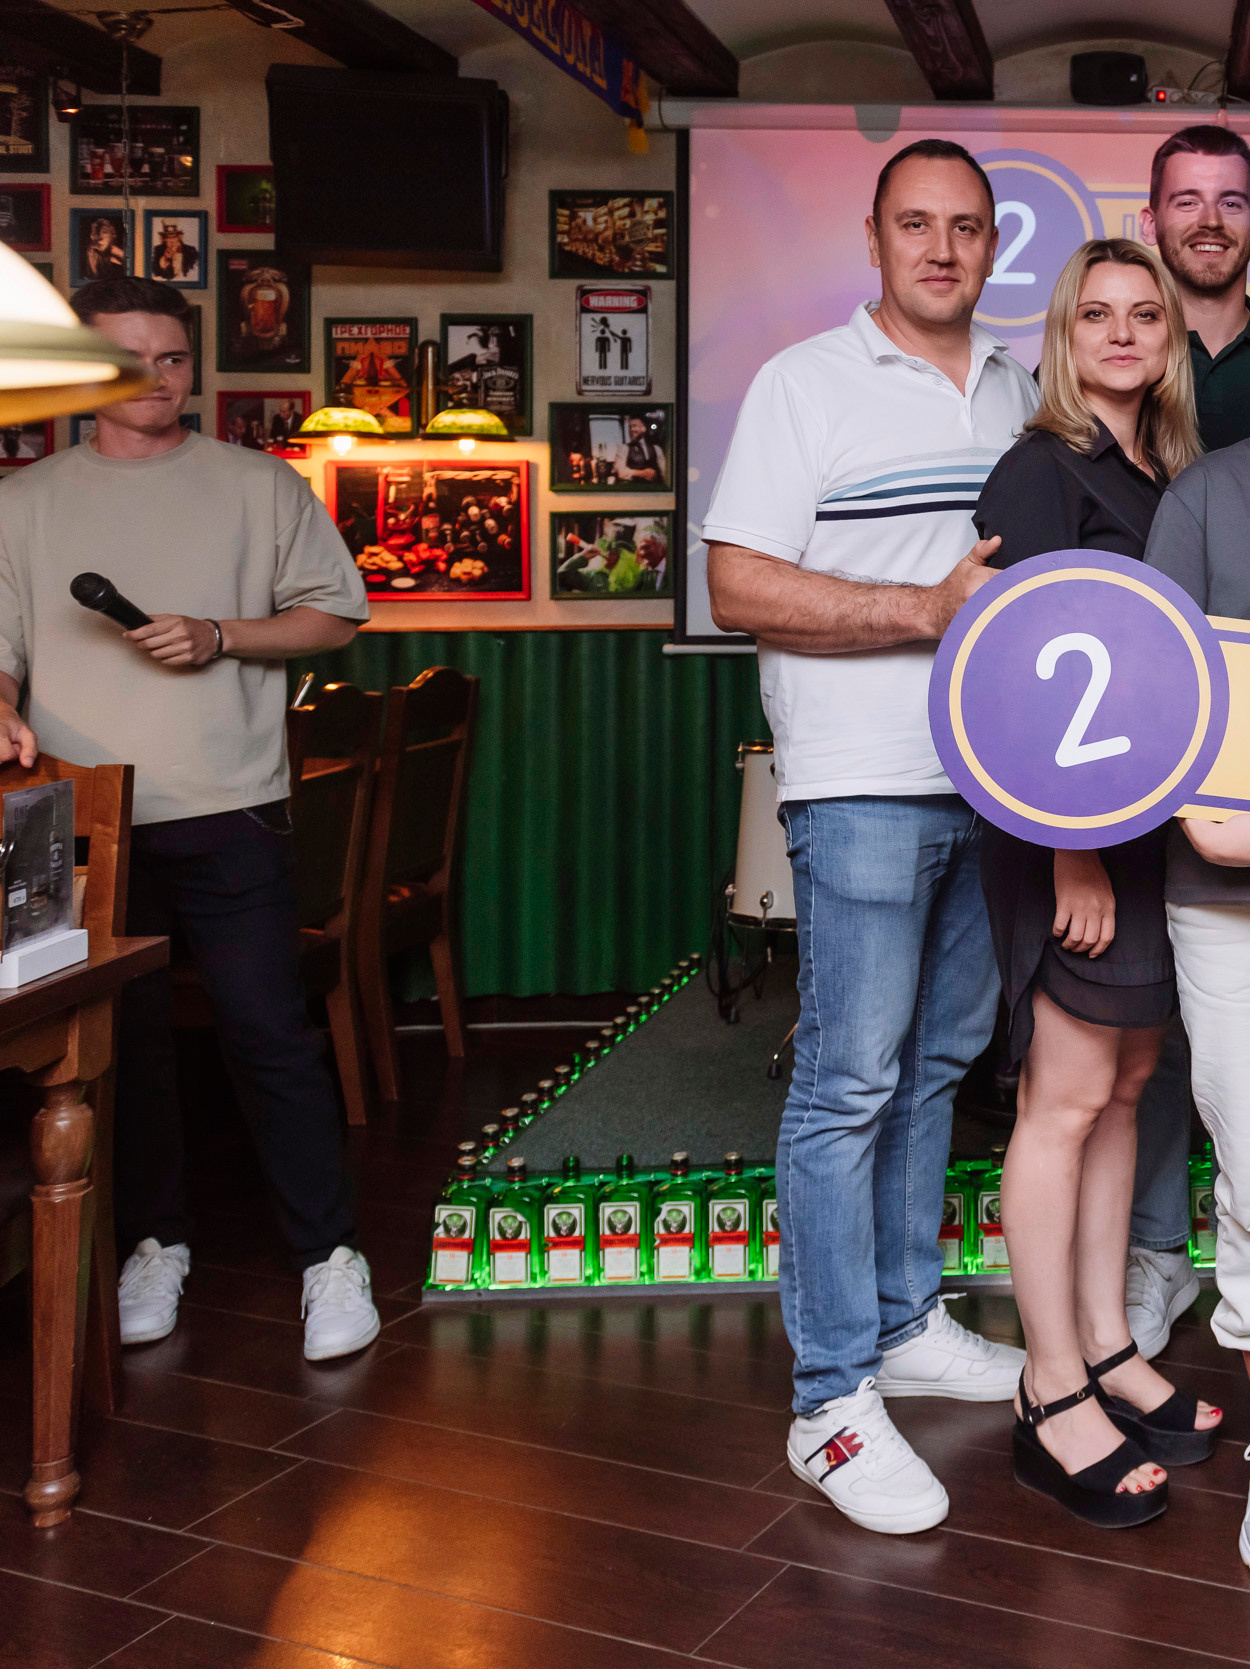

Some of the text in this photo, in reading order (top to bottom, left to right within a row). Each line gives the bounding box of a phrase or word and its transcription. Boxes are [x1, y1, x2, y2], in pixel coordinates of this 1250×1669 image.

[986, 200, 1037, 284] 2
[589, 295, 638, 308] WARNING
[582, 375, 612, 386] NERVOUS
[1034, 631, 1132, 768] 2
